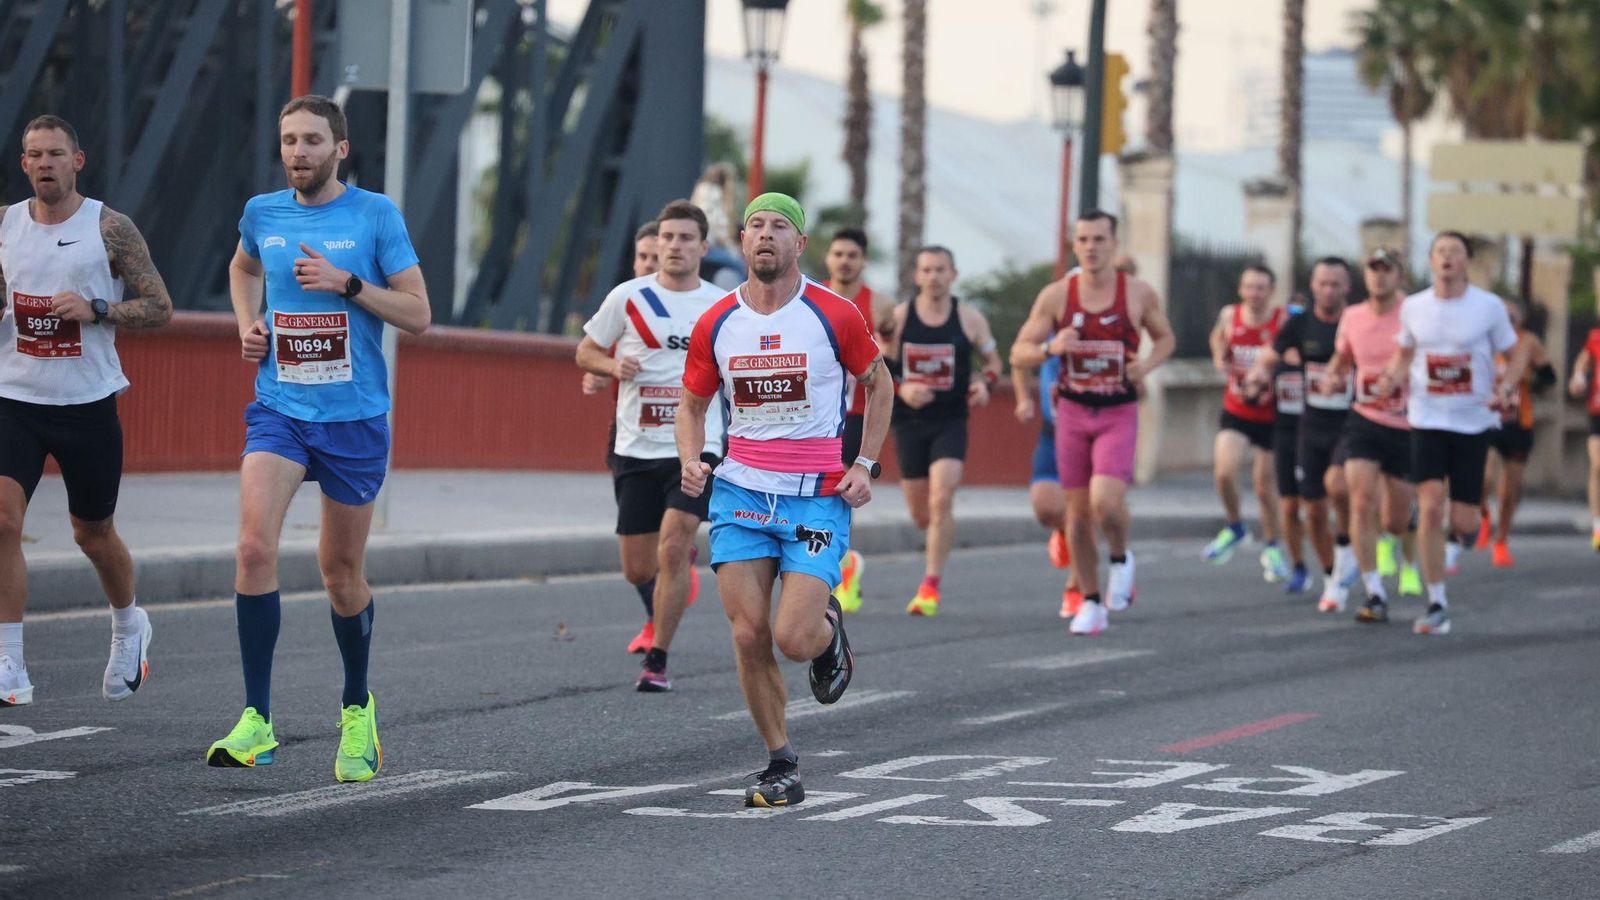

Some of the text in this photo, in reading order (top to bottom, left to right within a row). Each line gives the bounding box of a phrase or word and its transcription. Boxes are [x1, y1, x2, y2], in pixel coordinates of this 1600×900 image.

[323, 239, 356, 251] sparta
[27, 297, 53, 308] GENE
[27, 317, 61, 330] 5997
[288, 316, 341, 327] GENERALI
[286, 338, 333, 353] 10694
[667, 335, 690, 351] SS
[750, 356, 802, 369] GENERALI
[745, 379, 793, 394] 17032
